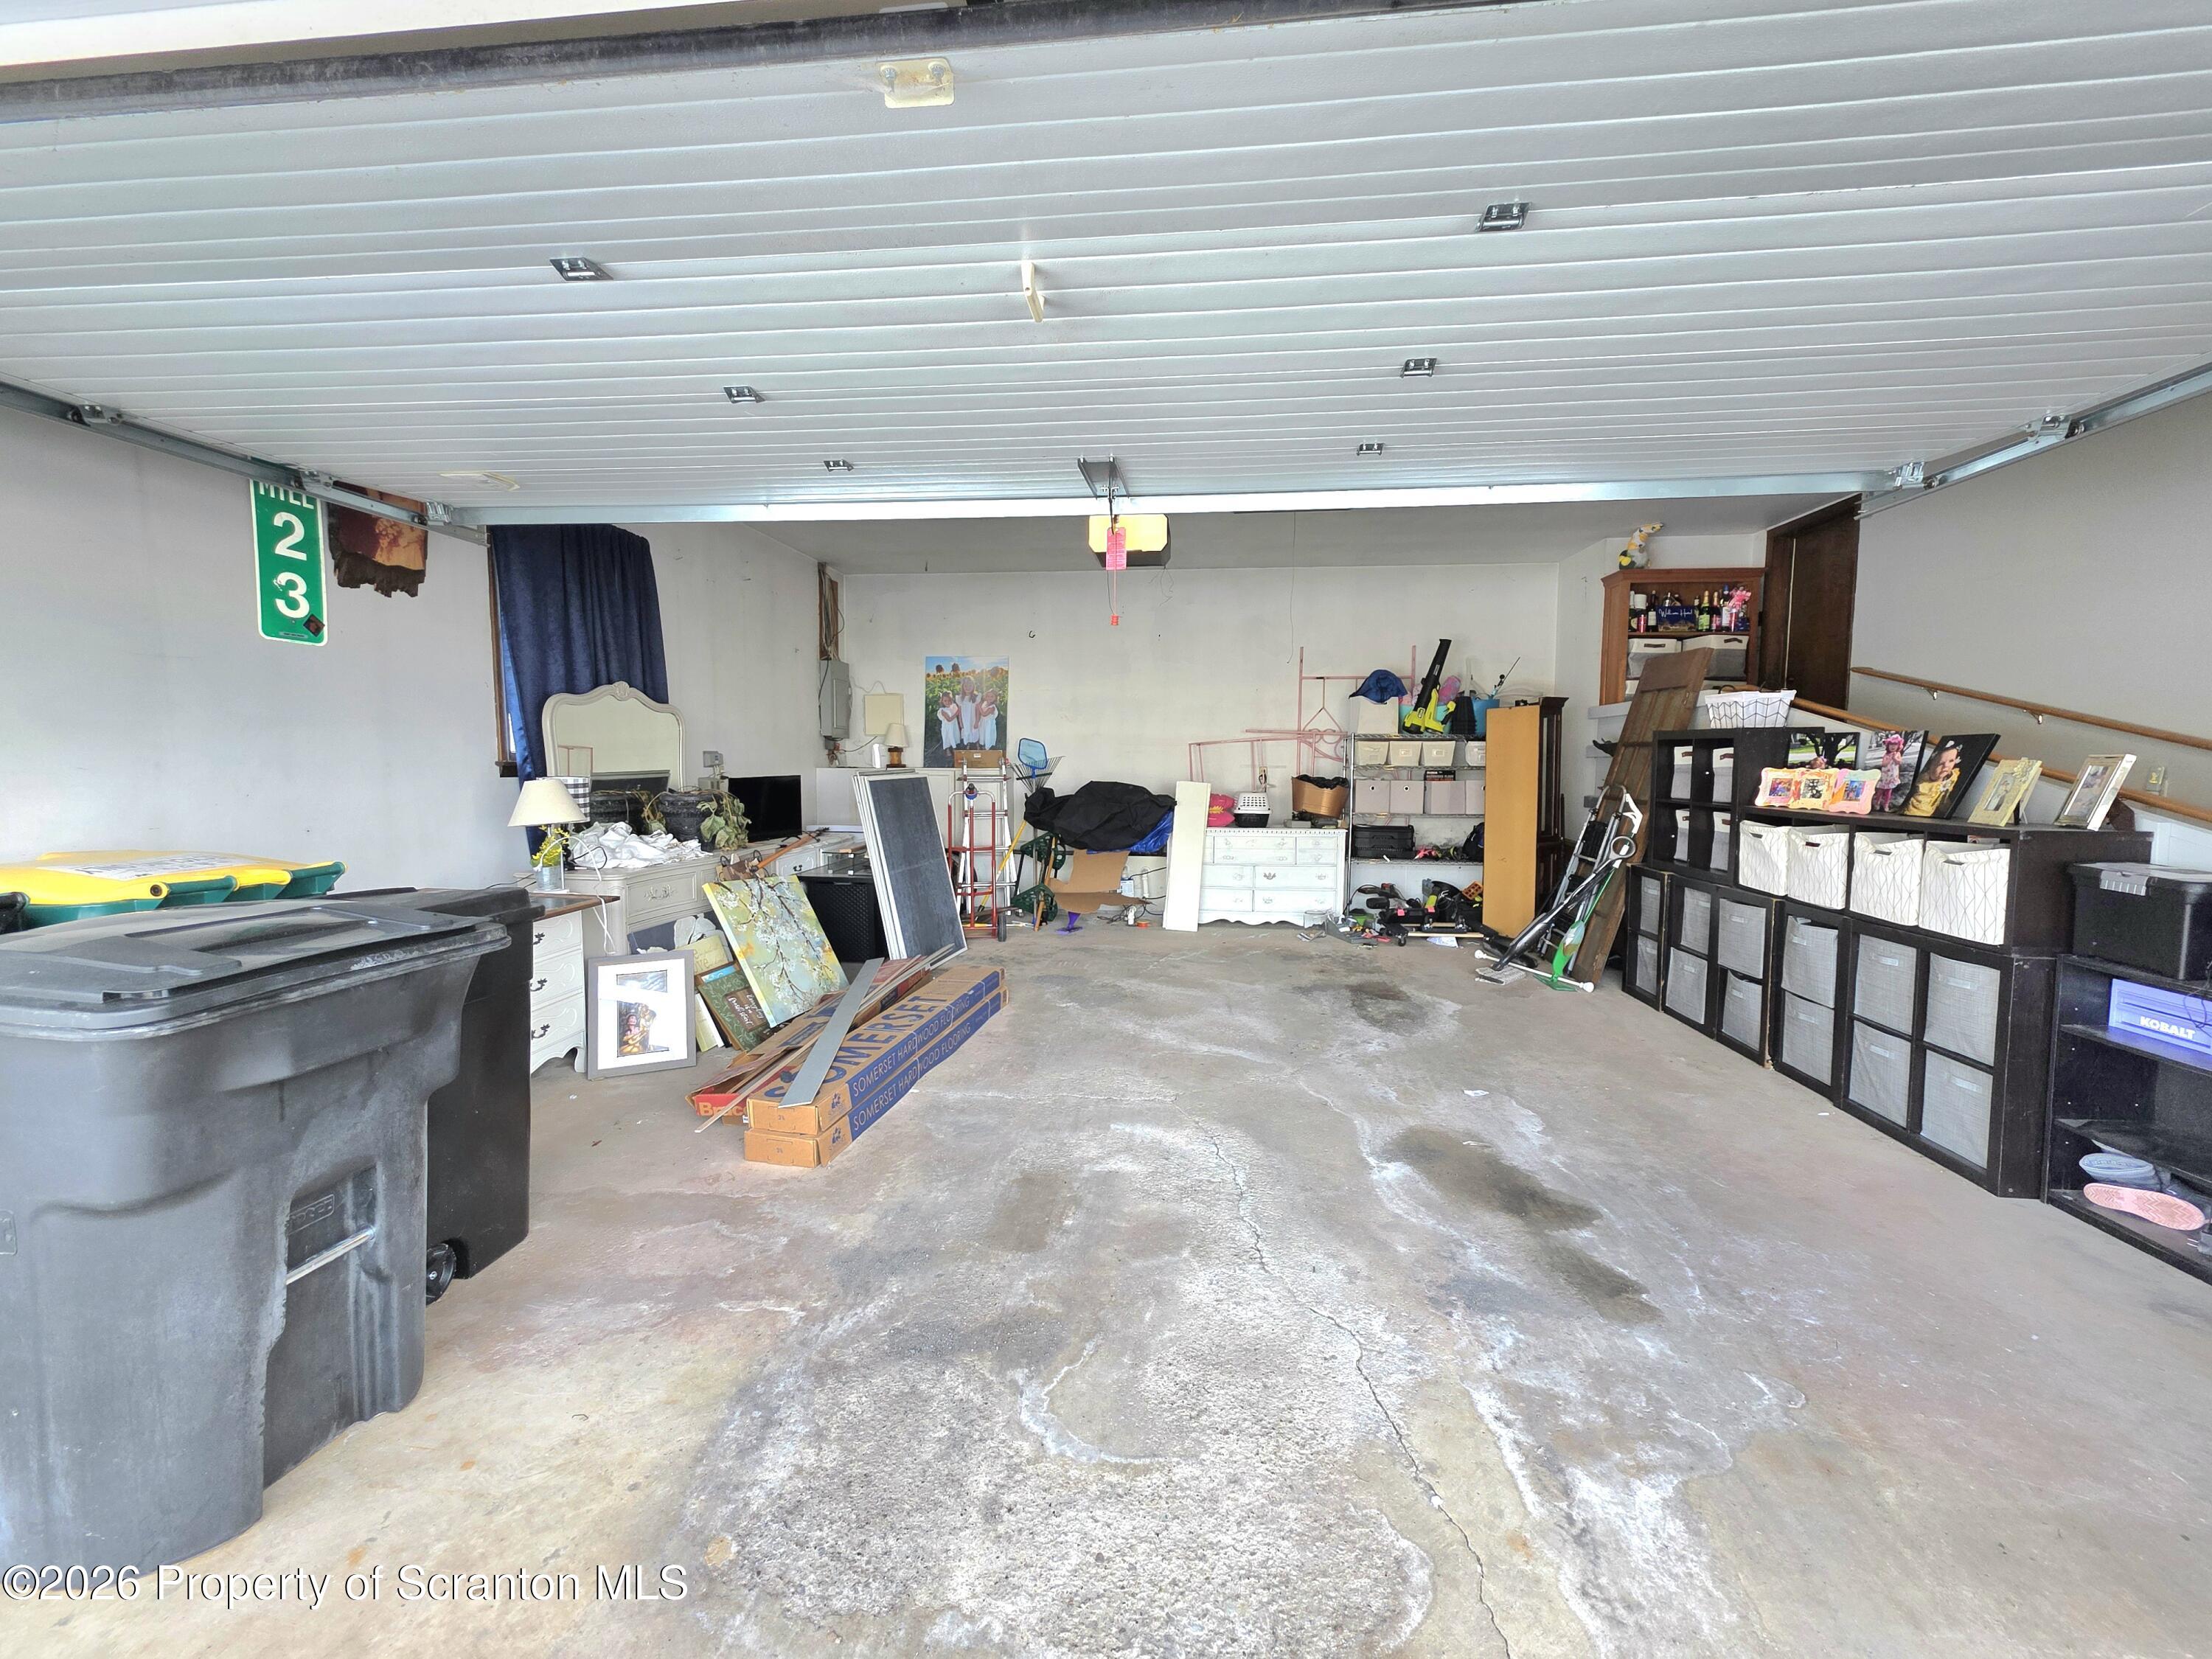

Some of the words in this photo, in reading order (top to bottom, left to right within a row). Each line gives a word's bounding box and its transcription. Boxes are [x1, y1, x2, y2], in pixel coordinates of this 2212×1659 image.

[852, 1052, 897, 1097] SOMERSET
[897, 1019, 939, 1060] HARDWOOD
[939, 996, 970, 1028] FLOORING
[853, 1084, 897, 1131] SOMERSET
[897, 1051, 939, 1091] HARDWOOD
[939, 1023, 971, 1055] FLOORING
[2140, 1015, 2196, 1040] KOBALT
